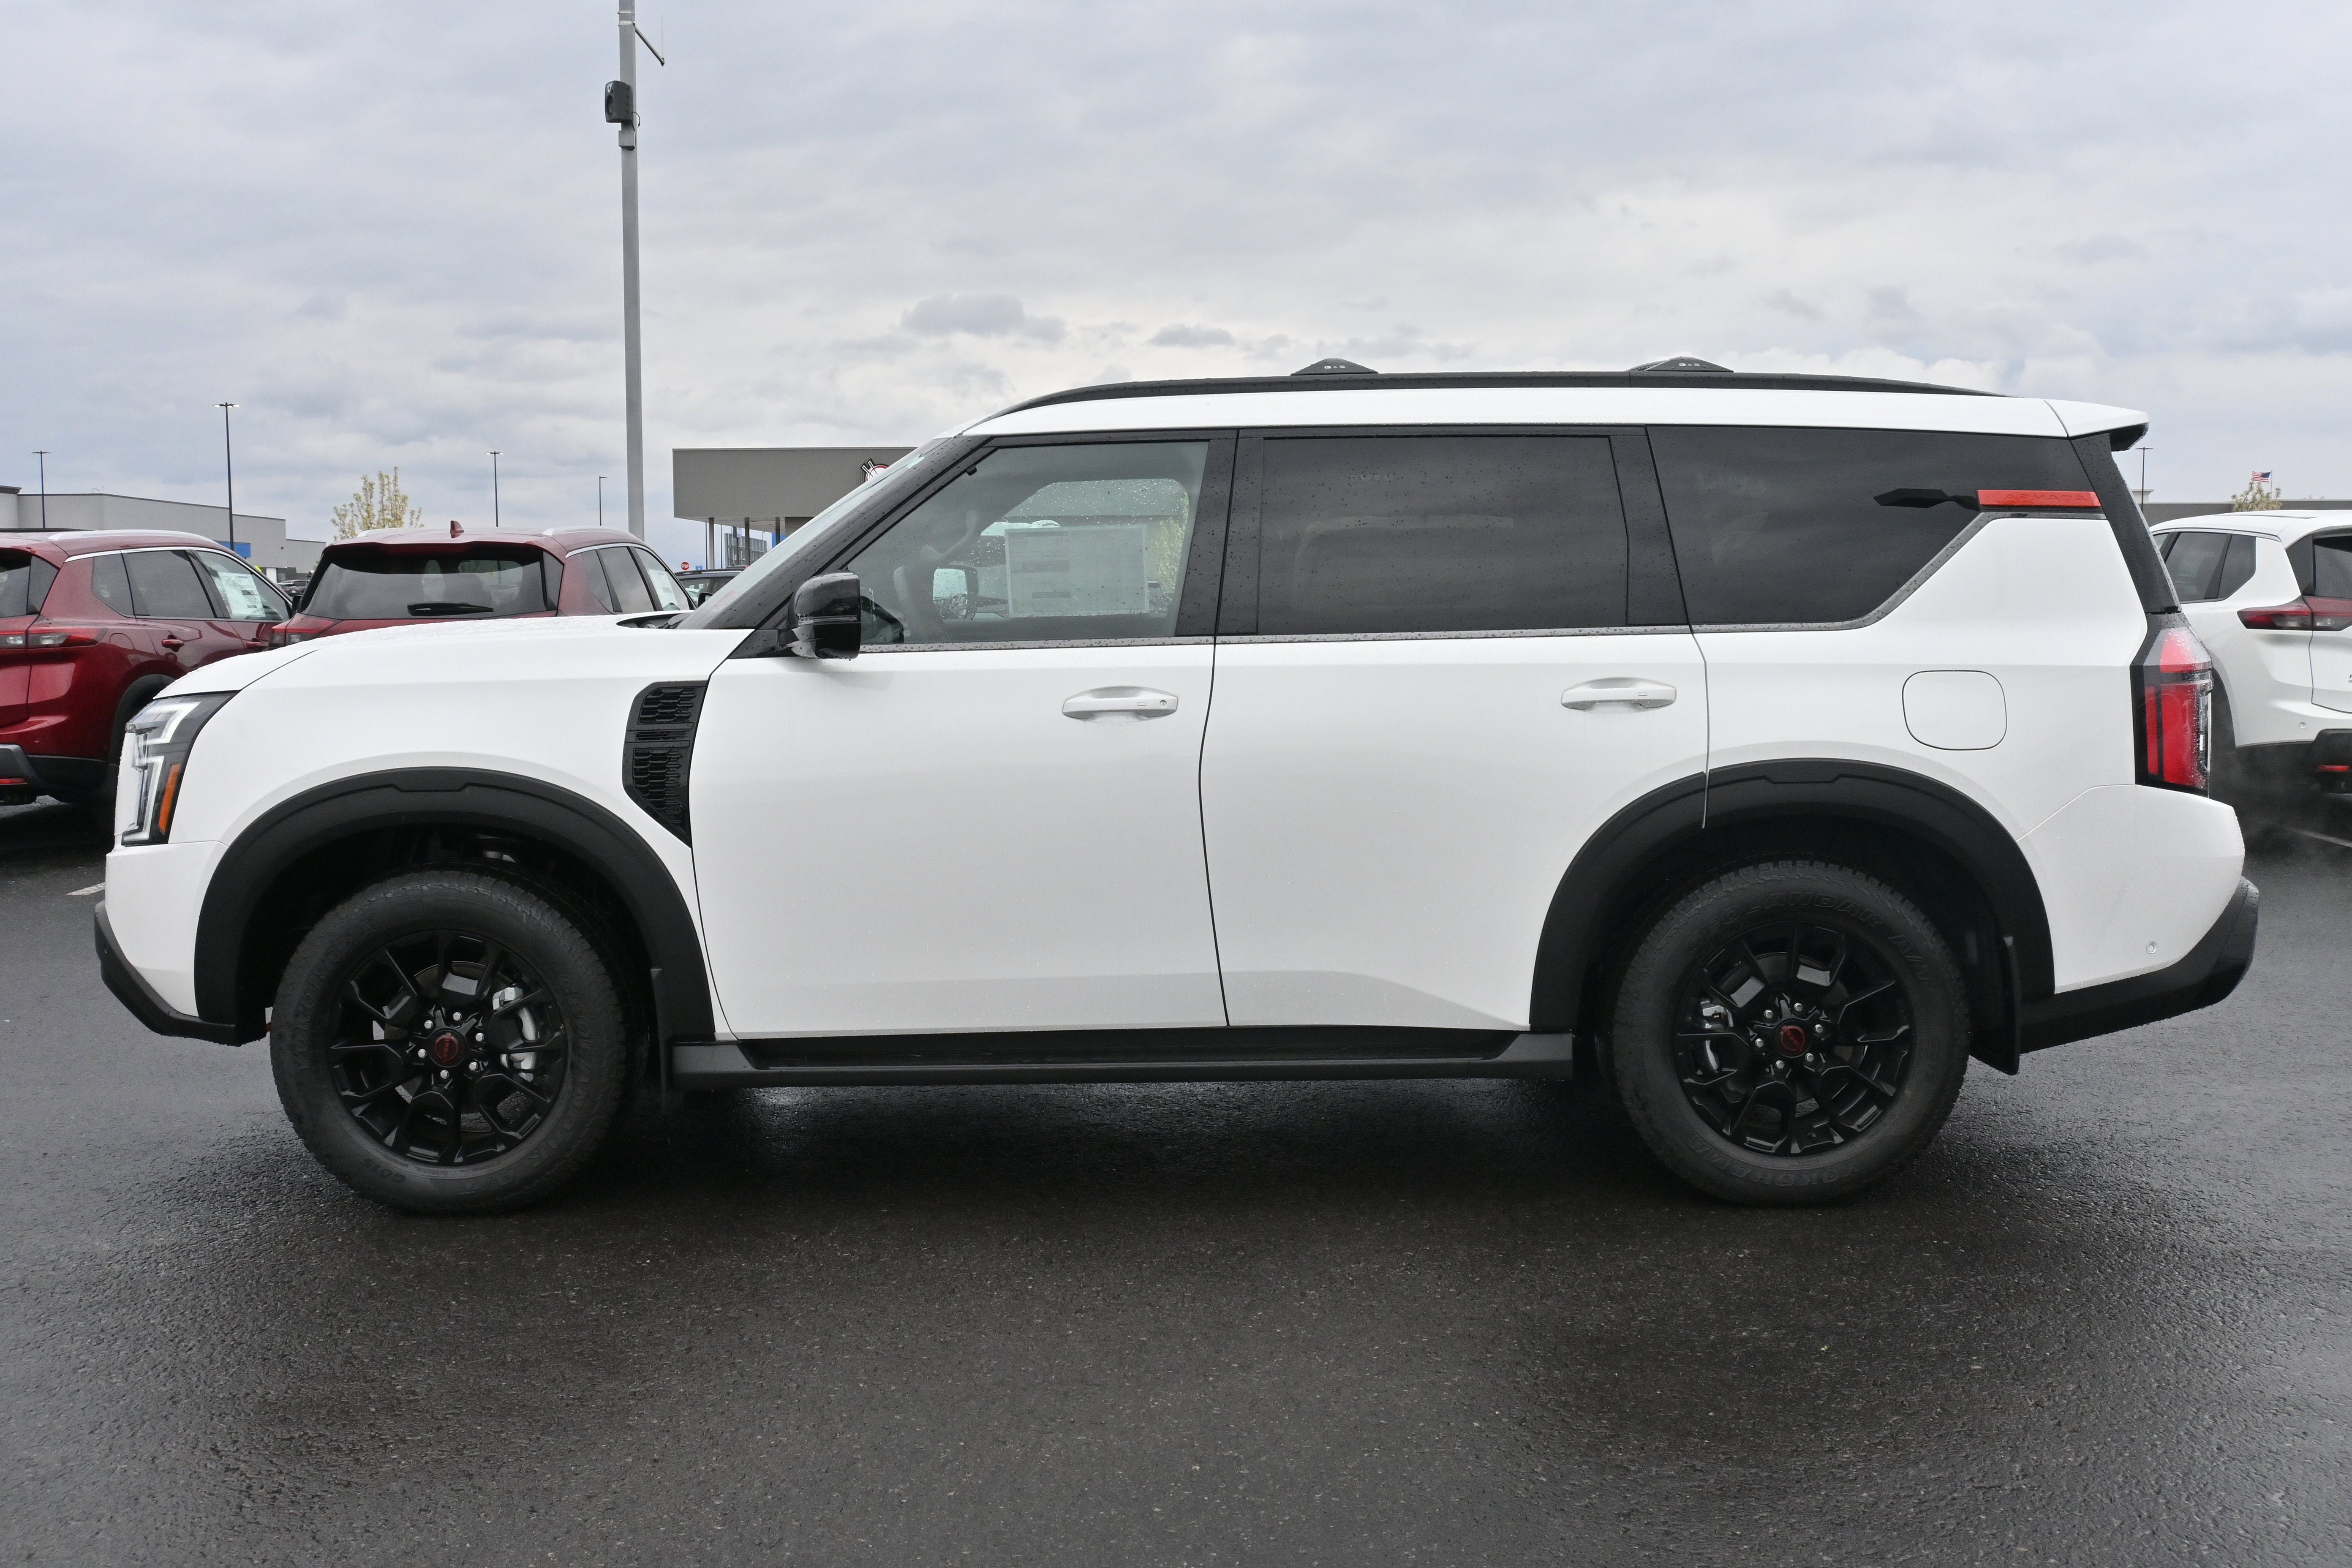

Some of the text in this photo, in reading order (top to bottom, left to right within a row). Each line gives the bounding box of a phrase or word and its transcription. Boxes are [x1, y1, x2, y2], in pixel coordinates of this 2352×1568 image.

[2005, 493, 2088, 501] ARMADA
[1681, 890, 1934, 986] GEOLANDAR A/T
[294, 917, 378, 1070] YOKOHAMA
[1687, 1134, 1860, 1187] YOKOHAMA
